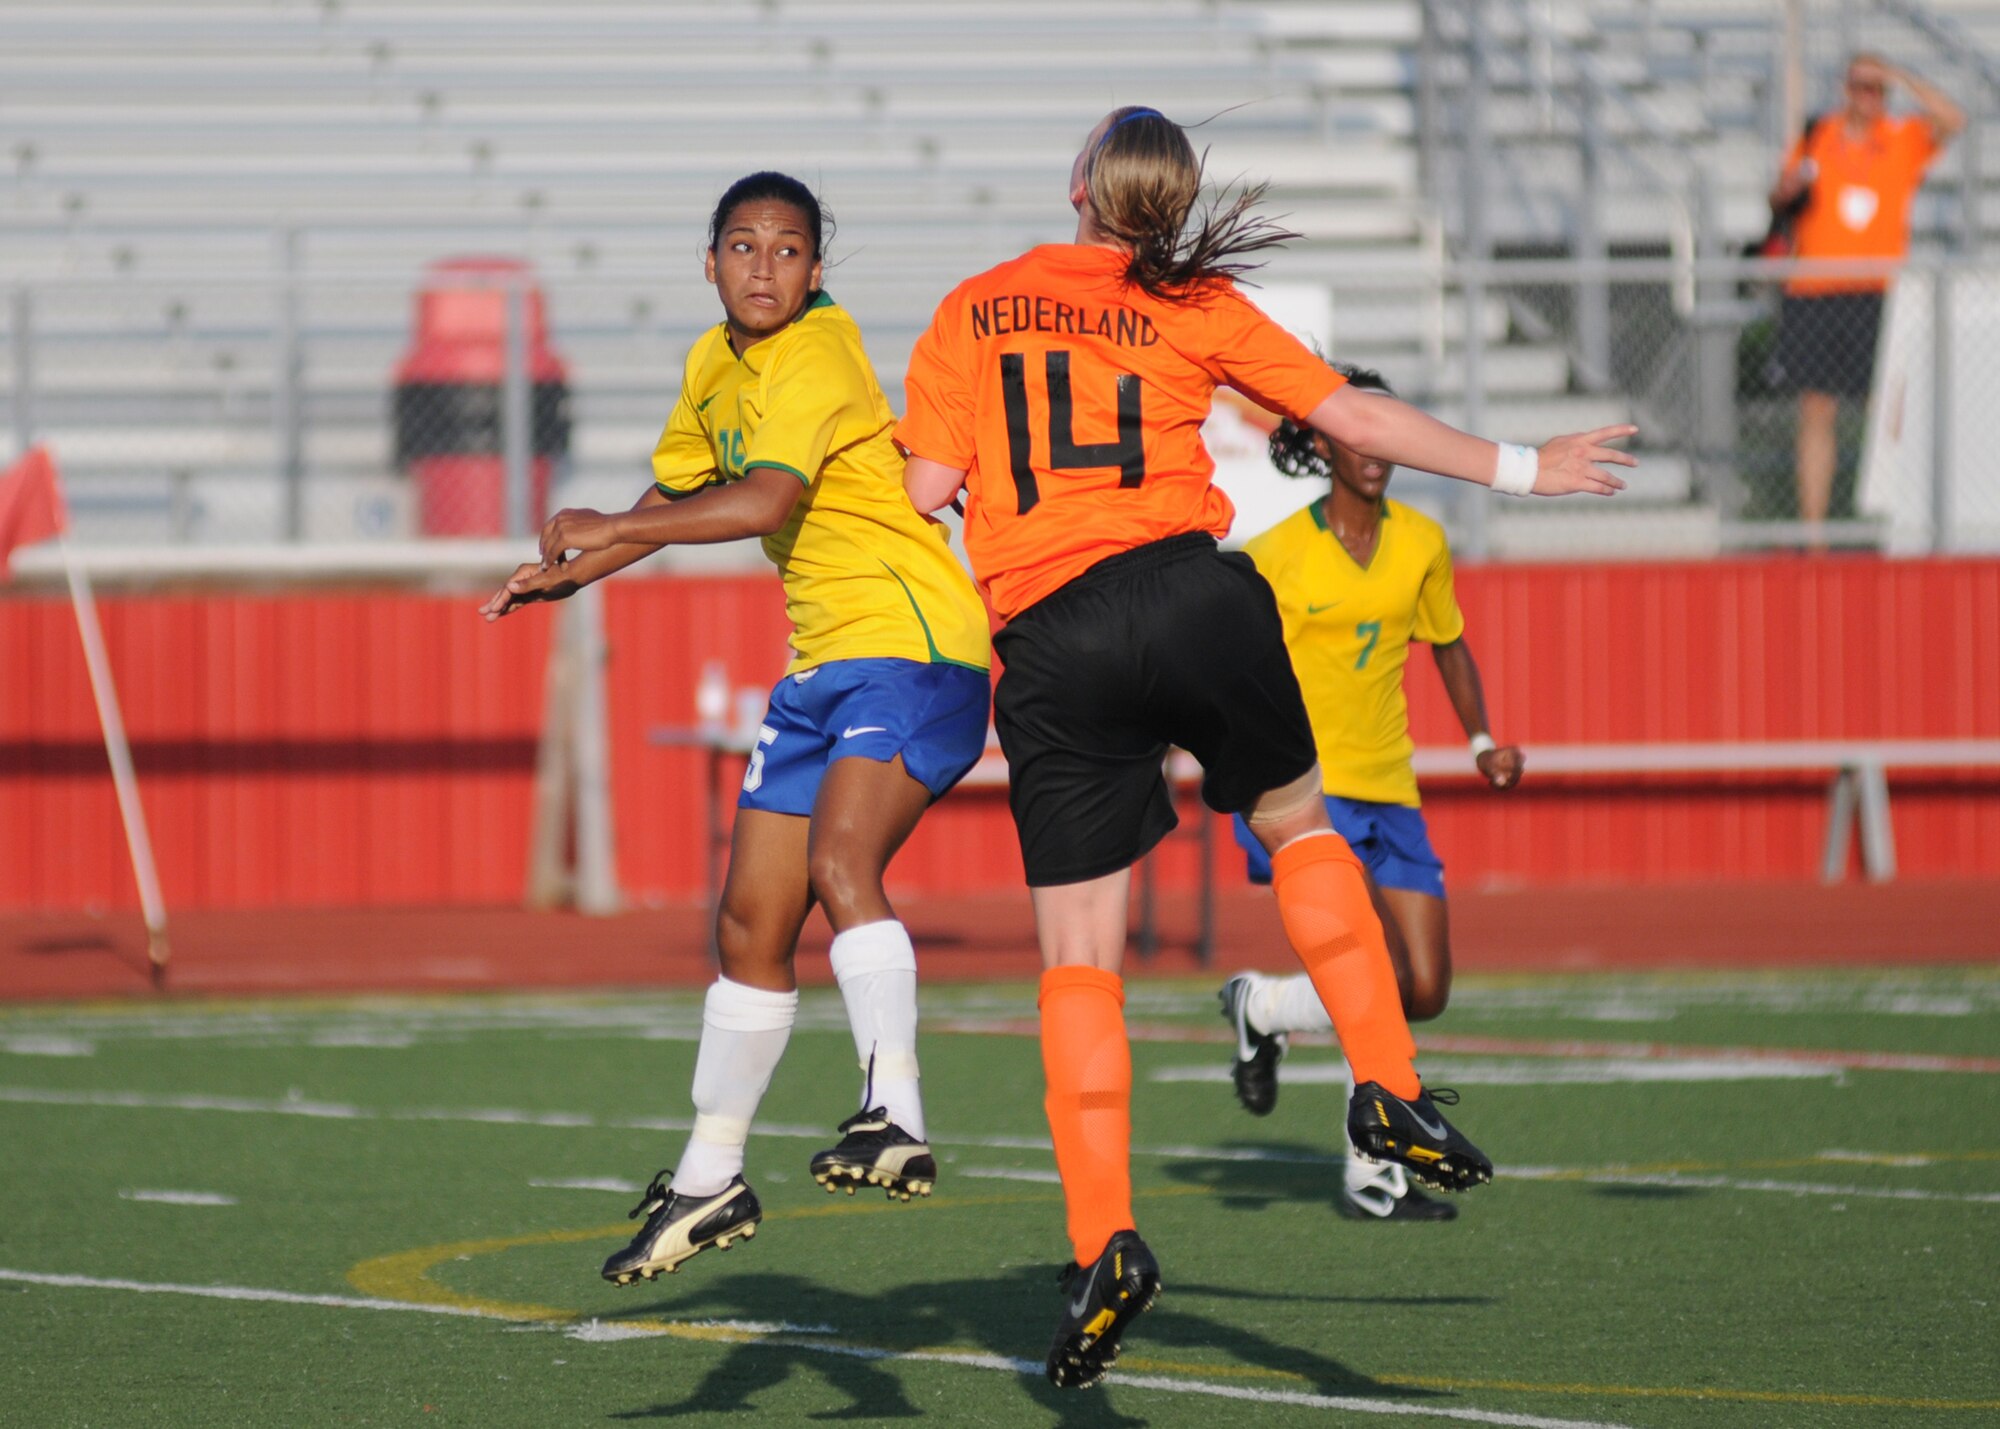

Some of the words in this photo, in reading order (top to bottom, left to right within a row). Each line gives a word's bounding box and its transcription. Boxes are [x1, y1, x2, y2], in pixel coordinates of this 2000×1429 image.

[971, 295, 1160, 347] NEDERLAND
[1000, 350, 1146, 516] 14
[1355, 620, 1382, 671] 7
